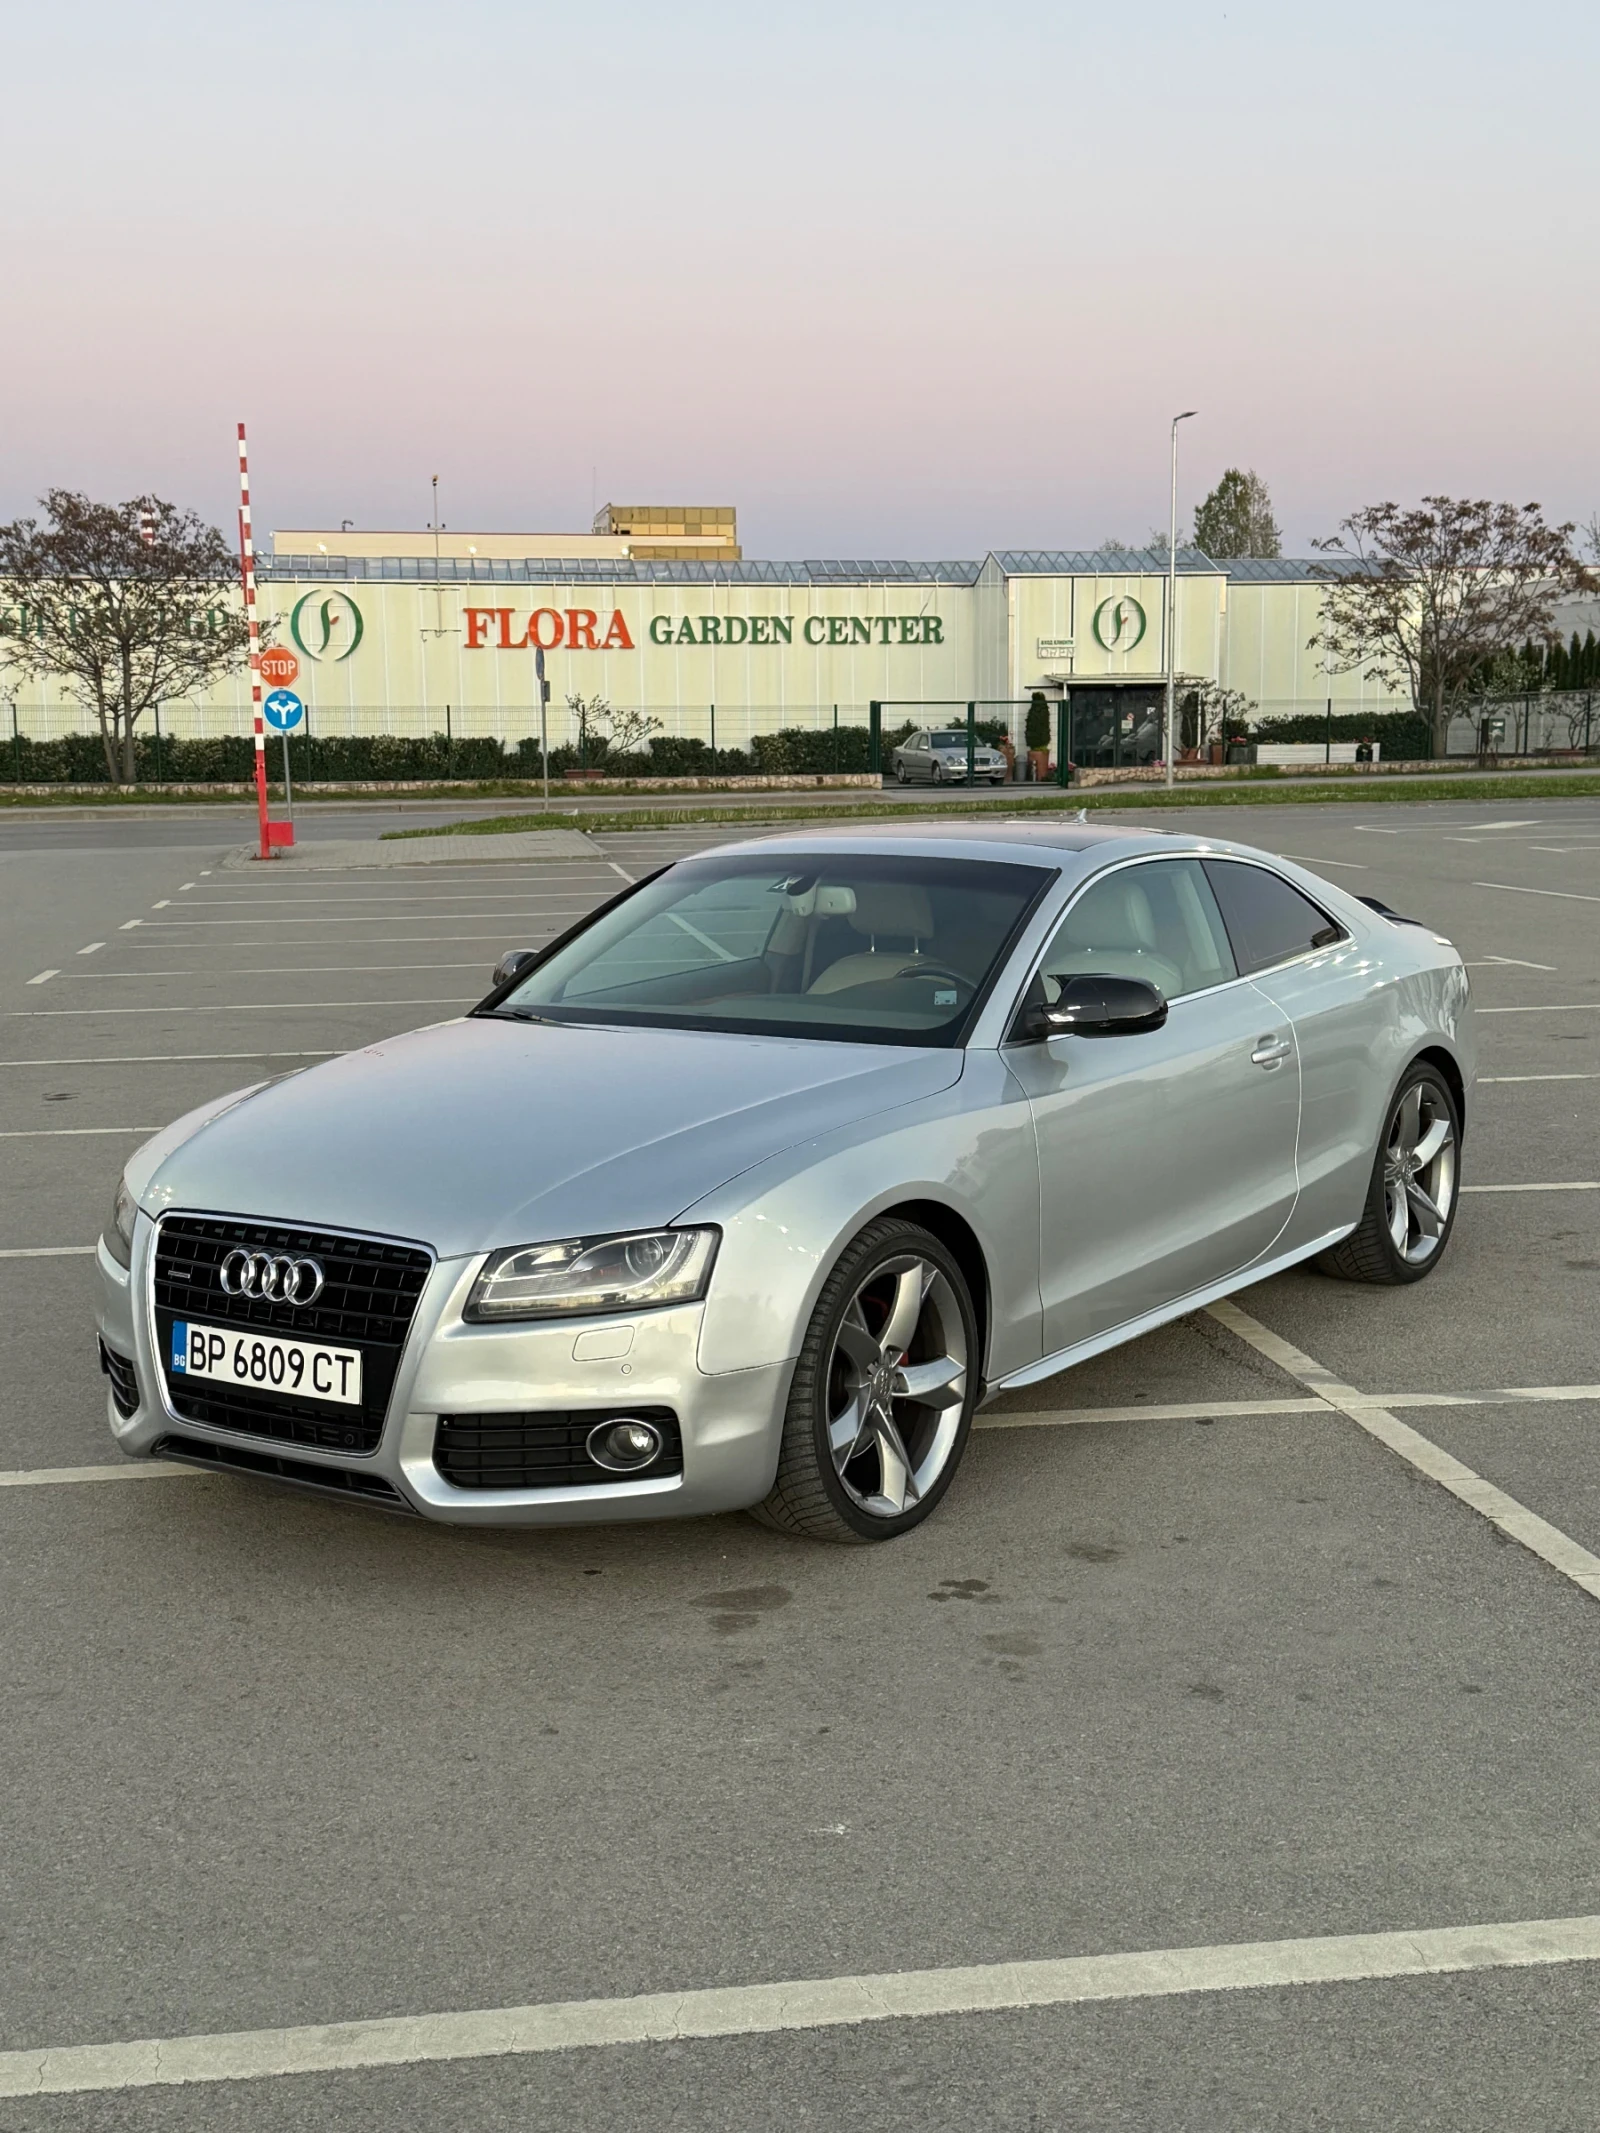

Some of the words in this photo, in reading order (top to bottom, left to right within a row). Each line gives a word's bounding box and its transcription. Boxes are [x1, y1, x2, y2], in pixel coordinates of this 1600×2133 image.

[463, 608, 635, 650] FLORA
[650, 615, 795, 645] GARDEN
[803, 615, 945, 645] CENTER
[261, 659, 296, 676] STOP
[173, 1353, 186, 1367] BG
[190, 1330, 226, 1373] BP
[233, 1338, 305, 1389] 6809
[313, 1351, 355, 1397] CT
